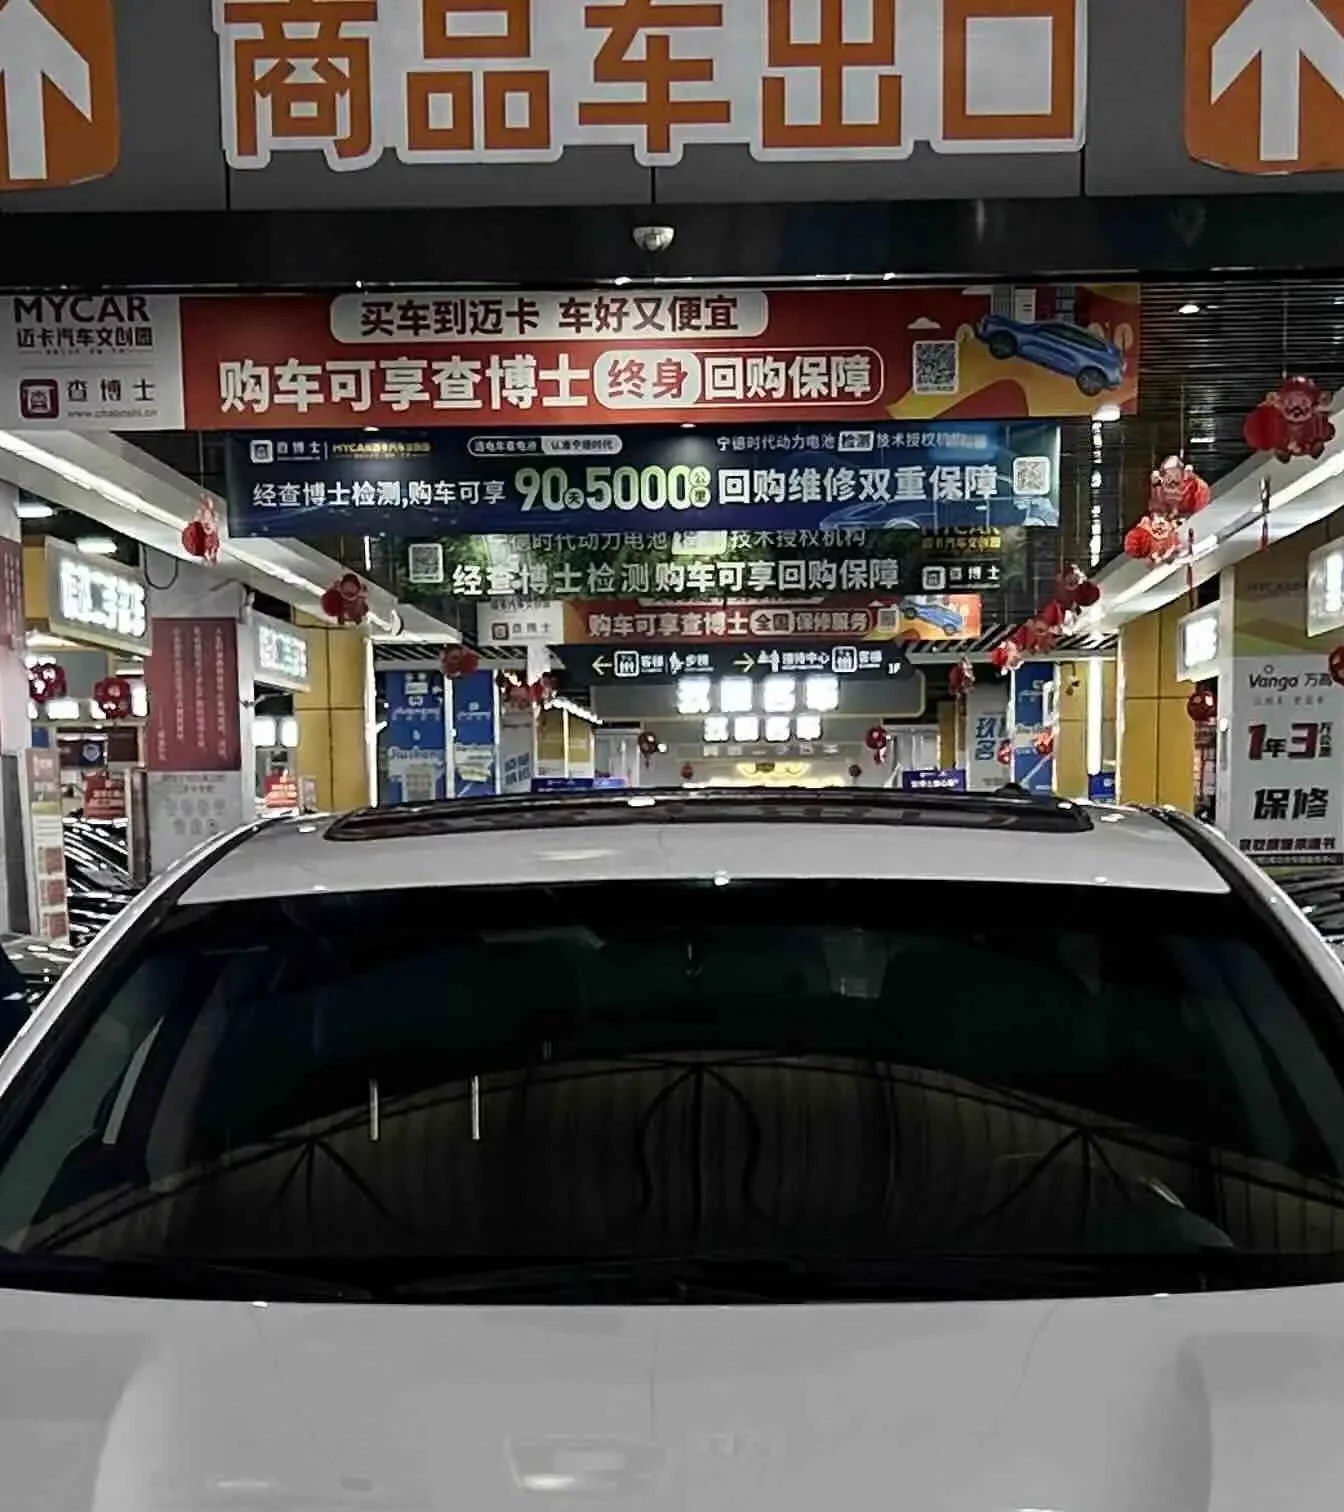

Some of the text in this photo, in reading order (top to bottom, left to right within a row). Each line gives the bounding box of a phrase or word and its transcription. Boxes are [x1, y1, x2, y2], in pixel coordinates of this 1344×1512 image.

[226, 0, 1086, 165] 商品车出口
[14, 296, 151, 323] MYCAR
[360, 296, 739, 336] 买车到迈卡 车好又便宜
[17, 327, 152, 348] 迈卡汽车文创园
[219, 353, 872, 412] 购车可享查博士 终身 回购保障
[718, 464, 999, 504] 回购维修双重保障
[1253, 788, 1329, 820] 保修
